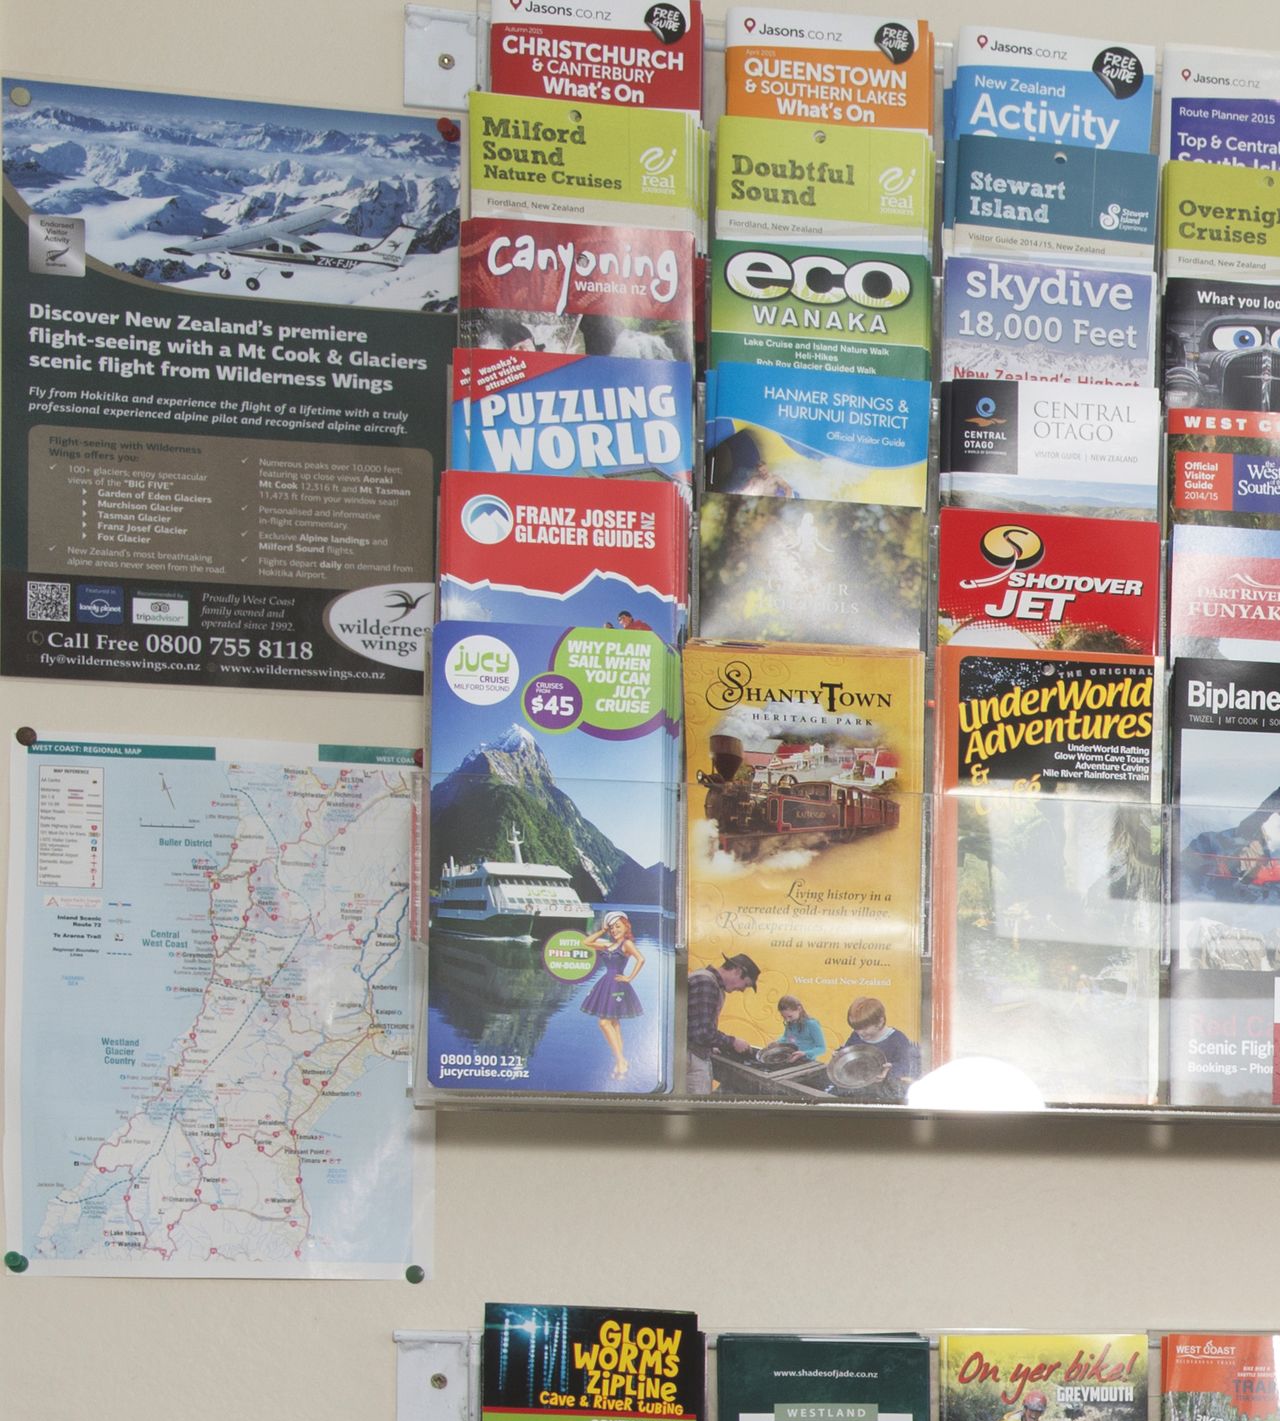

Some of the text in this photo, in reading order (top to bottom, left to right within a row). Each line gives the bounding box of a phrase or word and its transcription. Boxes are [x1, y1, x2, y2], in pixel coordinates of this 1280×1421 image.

[502, 34, 684, 72] CHRISTCHURCH
[532, 57, 654, 84] & CANTERBURY
[483, 116, 585, 145] Milford
[969, 93, 1119, 149] Activity
[483, 143, 564, 166] Sound
[483, 165, 622, 190] Nature Cruises
[970, 171, 1066, 200] Stewart
[970, 196, 1049, 224] Island
[725, 250, 911, 308] eco
[966, 260, 1133, 312] skydive
[29, 304, 119, 326] Discover
[125, 310, 171, 330] New
[279, 323, 368, 343] premiere
[752, 306, 888, 334] WANAKA
[957, 311, 1137, 348] 18,000 Feet
[29, 352, 393, 393] scenic flight from Wilderness Wings
[483, 384, 675, 427] PUZZLING
[764, 386, 908, 412] HANMER SPRINGS &
[778, 405, 908, 429] HURUNUI DISTRICT
[483, 422, 681, 471] WORLD
[516, 506, 637, 530] FRANZ JOSEF
[515, 525, 656, 549] GLACIER GUIDES
[1008, 571, 1142, 597] SHOTOVER
[986, 591, 1076, 621] JET
[47, 632, 313, 660] Call Free 0800 755 8118
[220, 662, 385, 680] www.wildernesswings.co.nz
[531, 694, 574, 716] $45
[1187, 680, 1280, 715] Biplane
[32, 744, 51, 753] WEST
[83, 746, 123, 755] REGIONAL
[125, 747, 142, 755] MAP
[964, 712, 1151, 763] Adventures
[440, 1066, 529, 1081] jucycruise.co.nz
[1057, 1386, 1133, 1402] GREYMOUTH
[787, 1408, 867, 1418] WESTLAND
